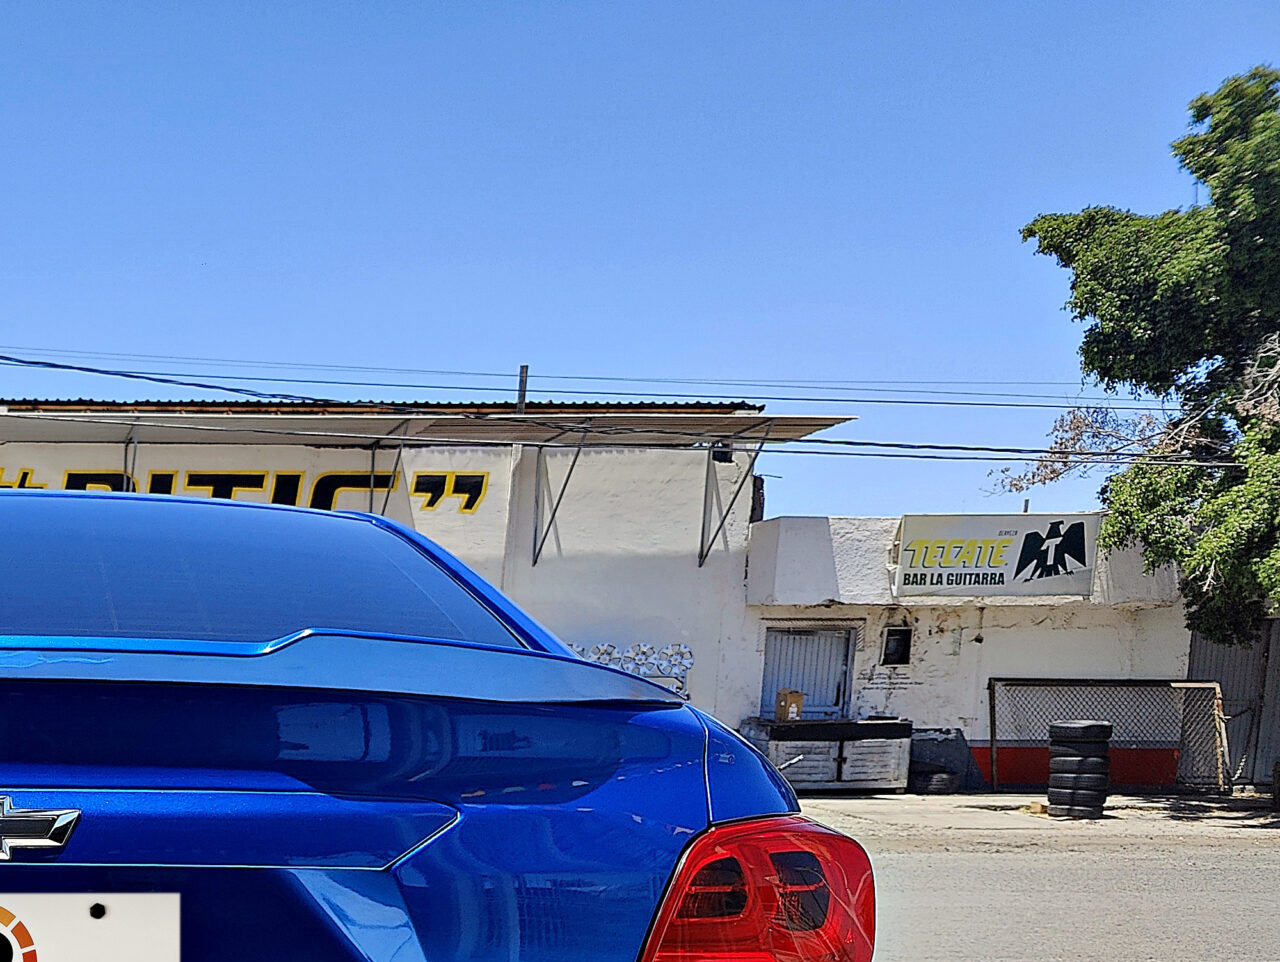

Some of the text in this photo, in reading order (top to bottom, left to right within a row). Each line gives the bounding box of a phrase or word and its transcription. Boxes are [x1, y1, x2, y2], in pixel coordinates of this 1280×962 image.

[903, 538, 1014, 569] TECATE
[903, 572, 1005, 586] BAR LA GUITARRA
